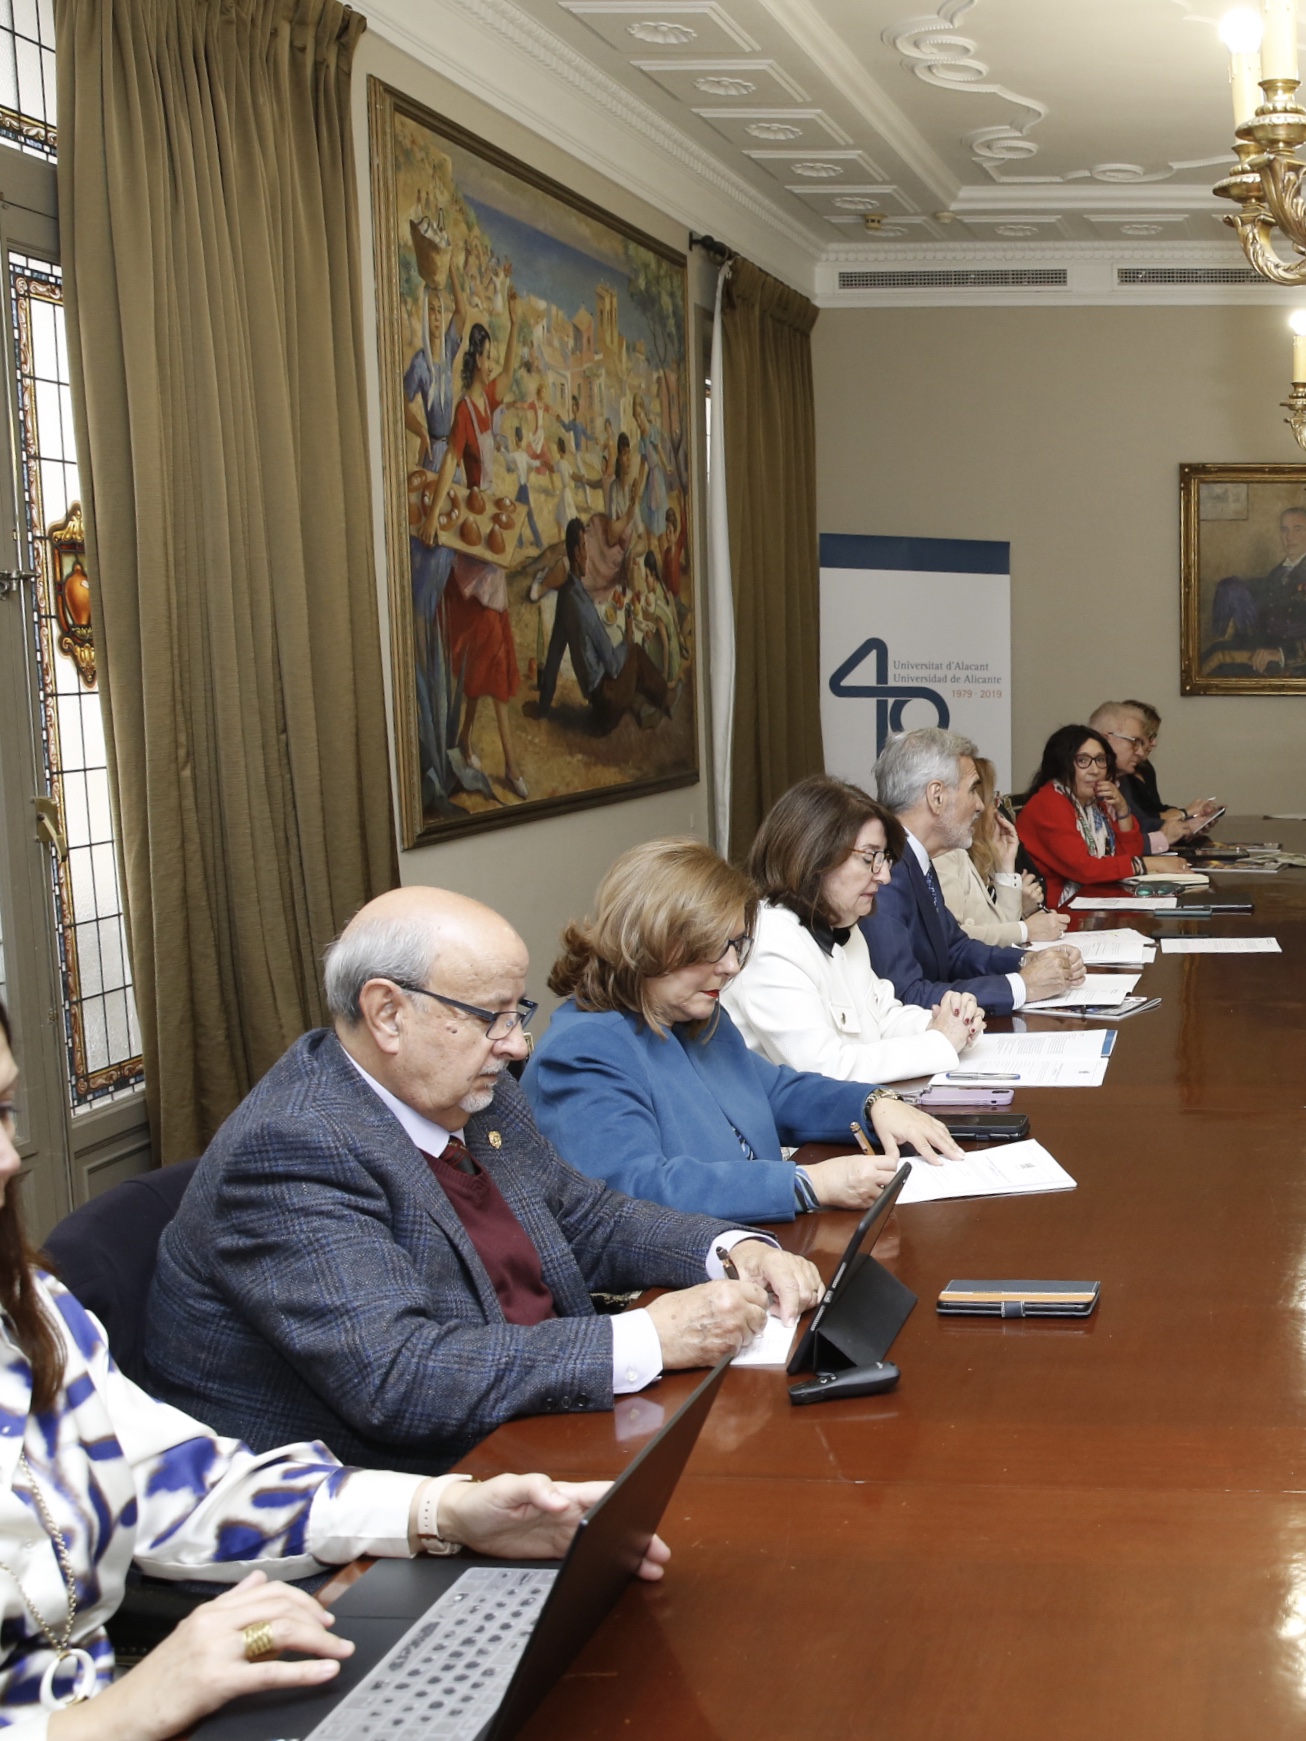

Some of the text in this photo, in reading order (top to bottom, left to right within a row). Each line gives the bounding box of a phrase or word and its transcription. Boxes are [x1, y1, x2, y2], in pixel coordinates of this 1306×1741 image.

[893, 660, 988, 671] Universitat d'Alacant
[893, 674, 1002, 684] Universidad de Alicante
[952, 690, 1002, 698] 1979 2019
